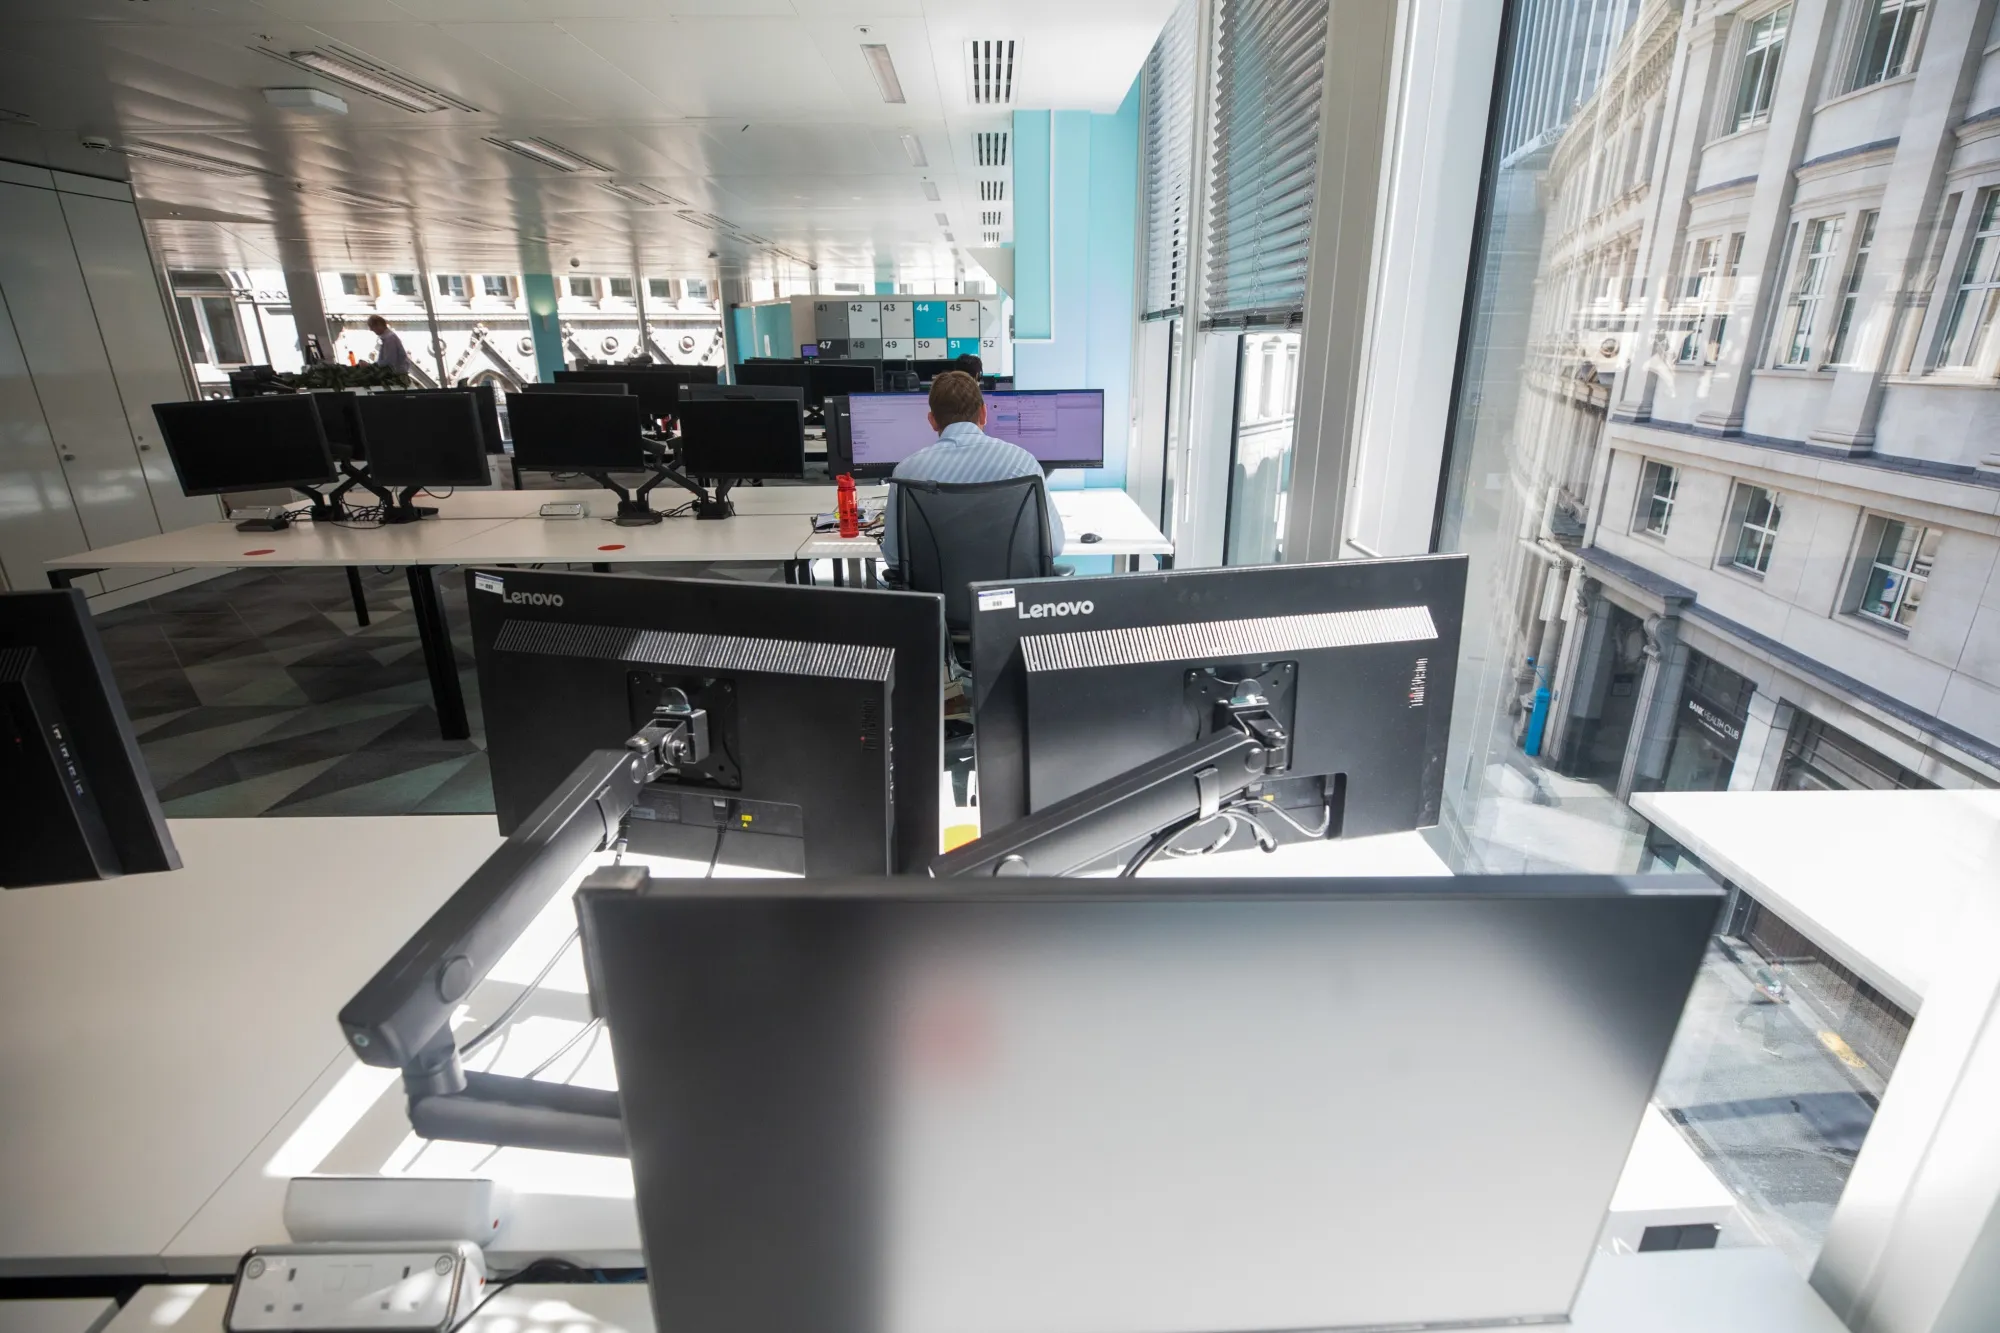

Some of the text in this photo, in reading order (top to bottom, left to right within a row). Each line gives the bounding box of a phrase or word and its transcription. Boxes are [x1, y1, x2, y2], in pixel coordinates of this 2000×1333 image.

[502, 588, 564, 606] Lenovo
[1018, 600, 1094, 619] Lenovo
[1689, 700, 1704, 716] BANK
[1704, 710, 1724, 728] HEALTH
[1724, 724, 1740, 740] CLUB
